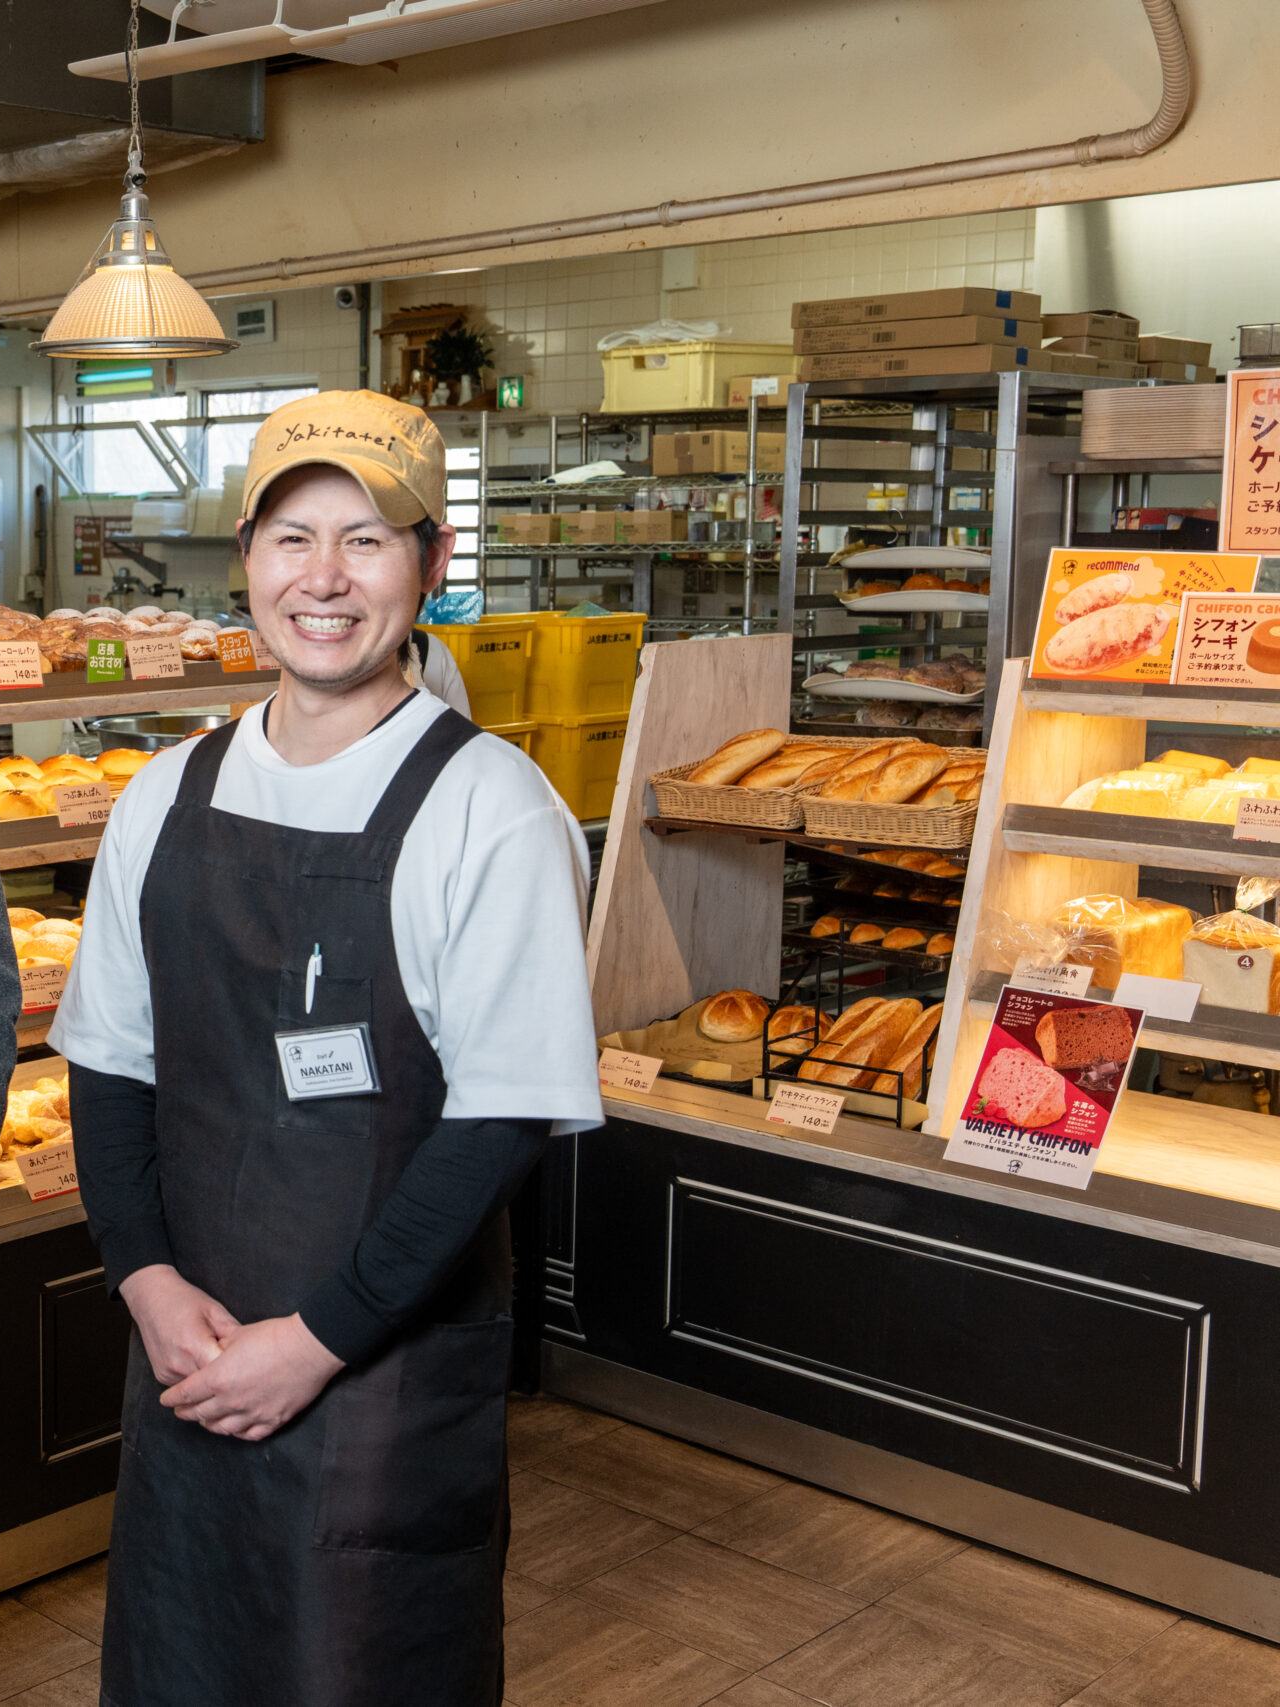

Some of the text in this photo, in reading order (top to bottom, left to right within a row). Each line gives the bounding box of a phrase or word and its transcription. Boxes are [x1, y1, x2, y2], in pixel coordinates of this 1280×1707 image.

[1251, 414, 1279, 442] シ
[1249, 445, 1280, 474] ケ
[1086, 560, 1140, 572] recommend
[1193, 617, 1257, 632] シフォン
[220, 634, 248, 649] スタッフ
[1191, 633, 1238, 650] ケーキ
[97, 643, 115, 656] 店長
[132, 643, 175, 654] シナモンロール
[221, 646, 251, 661] おすすめ
[89, 655, 122, 669] おすすめ
[1189, 652, 1236, 661] ホールサイズ
[159, 663, 173, 674] 170
[1187, 662, 1246, 672] ご予約承ります。
[14, 670, 30, 679] 140
[63, 787, 101, 799] つぶあんぱん
[88, 810, 103, 820] 160
[1241, 957, 1251, 966] 4
[22, 969, 64, 981] ュガーレーズン
[1007, 1001, 1033, 1010] シフォン
[1009, 994, 1054, 1007] チョコレートの
[300, 1062, 353, 1077] NAKATANI
[624, 1077, 641, 1088] 140
[1071, 1108, 1098, 1118] シフォン
[802, 1115, 821, 1127] 140
[965, 1116, 1093, 1156] VARIETY CHIFFON
[28, 1150, 69, 1168] あんドーナツ
[58, 1173, 77, 1185] 140
